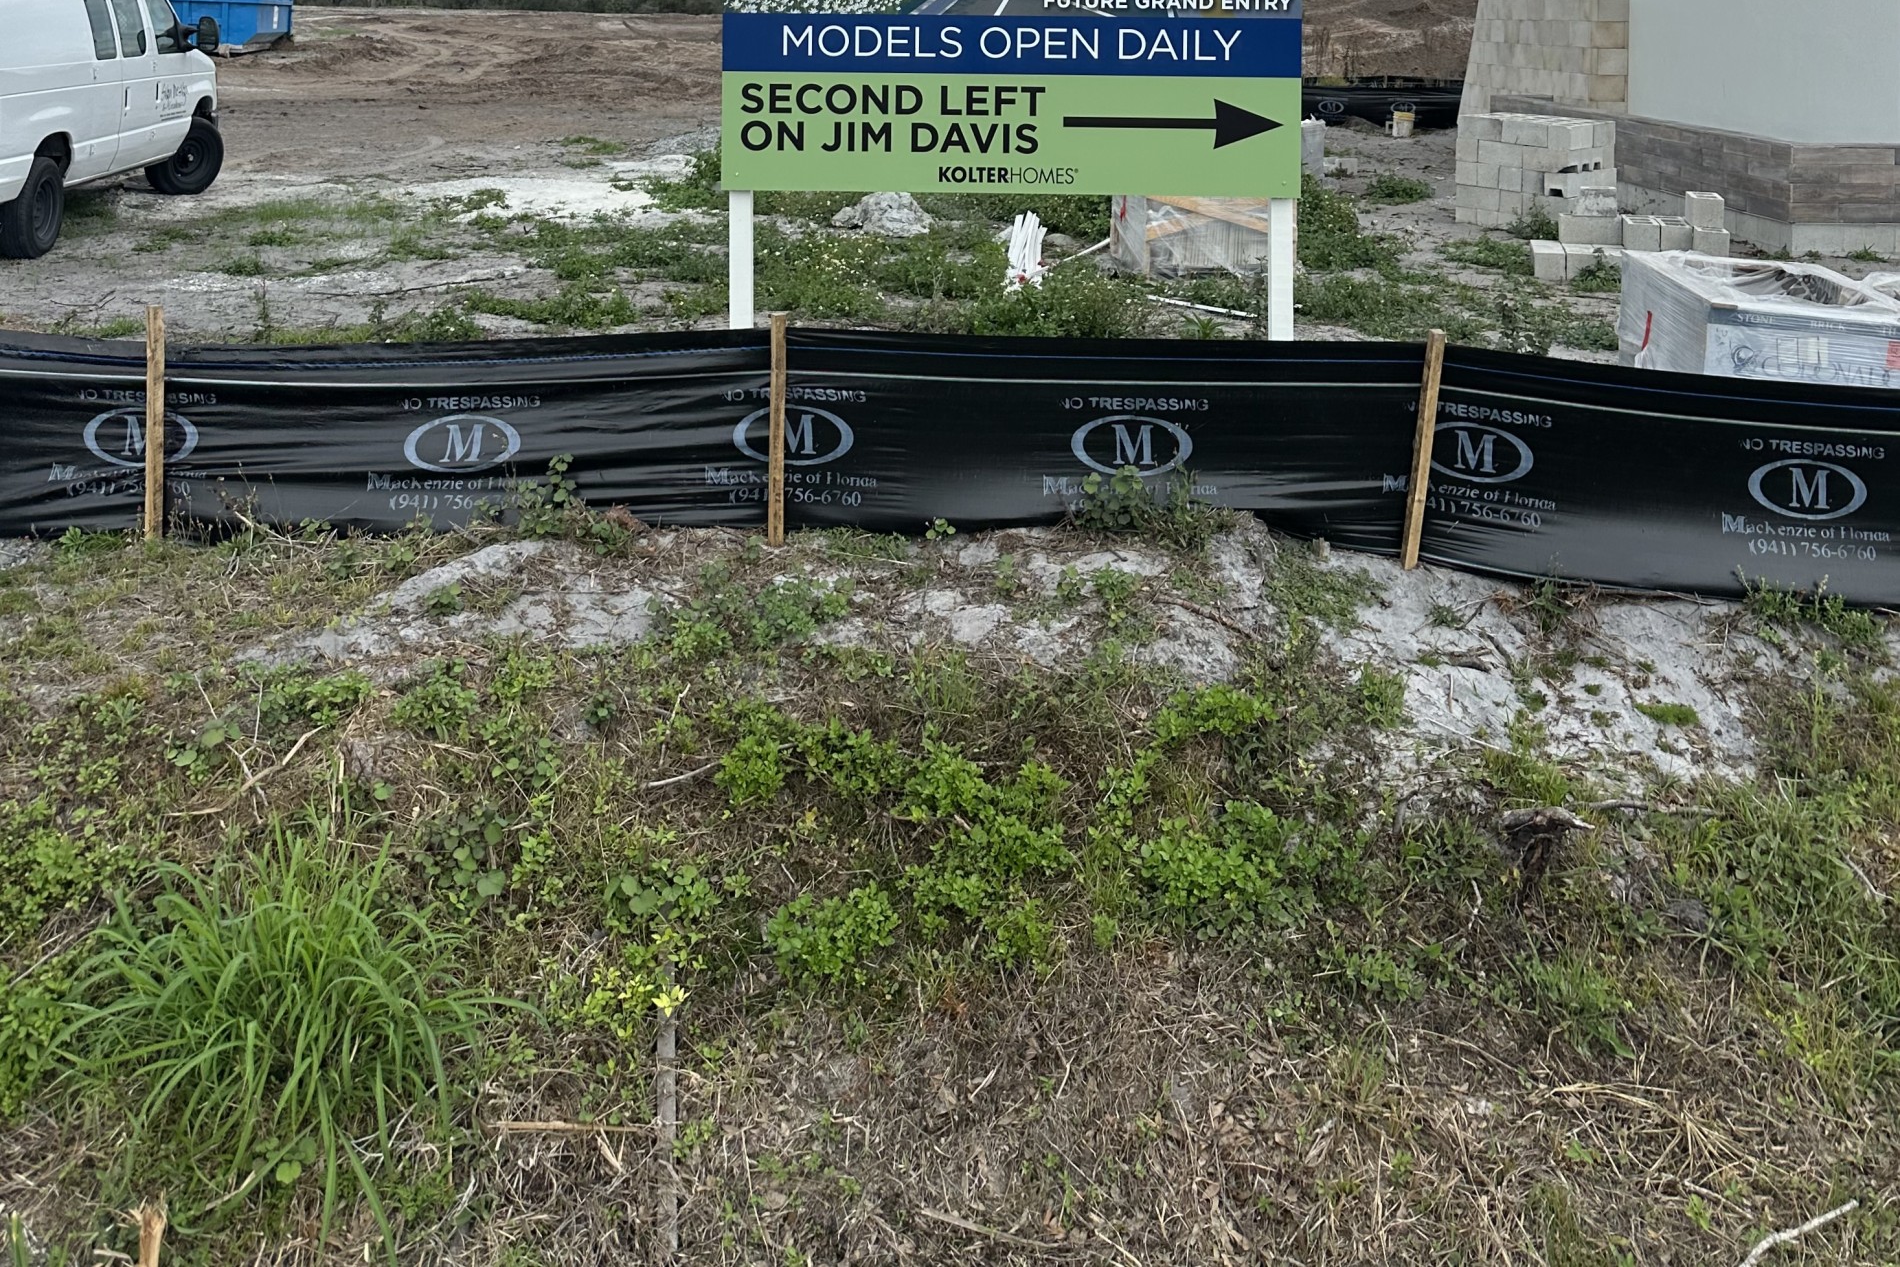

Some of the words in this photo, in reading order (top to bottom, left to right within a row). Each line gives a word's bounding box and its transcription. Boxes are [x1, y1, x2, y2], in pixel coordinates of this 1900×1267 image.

[782, 25, 962, 59] MODELS
[979, 27, 1100, 61] OPEN
[1118, 29, 1242, 62] DAILY
[740, 83, 923, 116] SECOND
[940, 85, 1046, 118] LEFT
[740, 120, 805, 152] ON
[821, 122, 892, 154] JIM
[910, 124, 1039, 155] DAVIS
[102, 389, 216, 404] TRESSSING
[400, 396, 422, 410] NO
[426, 395, 541, 410] TRESPASSING
[722, 389, 745, 401] NO
[750, 387, 866, 403] TRSPASSING
[1060, 397, 1084, 410] NO
[1088, 396, 1209, 411] TRESPASSING
[1436, 401, 1552, 428] TRESPASSING
[439, 423, 486, 463] M
[1111, 424, 1154, 465] M
[1454, 429, 1497, 474] M
[1739, 437, 1764, 450] NO
[1769, 439, 1885, 459] TRESPASSING
[805, 471, 821, 484] of
[1788, 467, 1831, 510] M
[389, 494, 438, 510] (941)
[729, 487, 768, 505] (941
[784, 487, 862, 507] 756-6760
[1426, 496, 1457, 514] 41)
[1460, 501, 1542, 528] 756-6760
[1748, 538, 1797, 556] (941)
[1800, 541, 1877, 561] 756-6760
